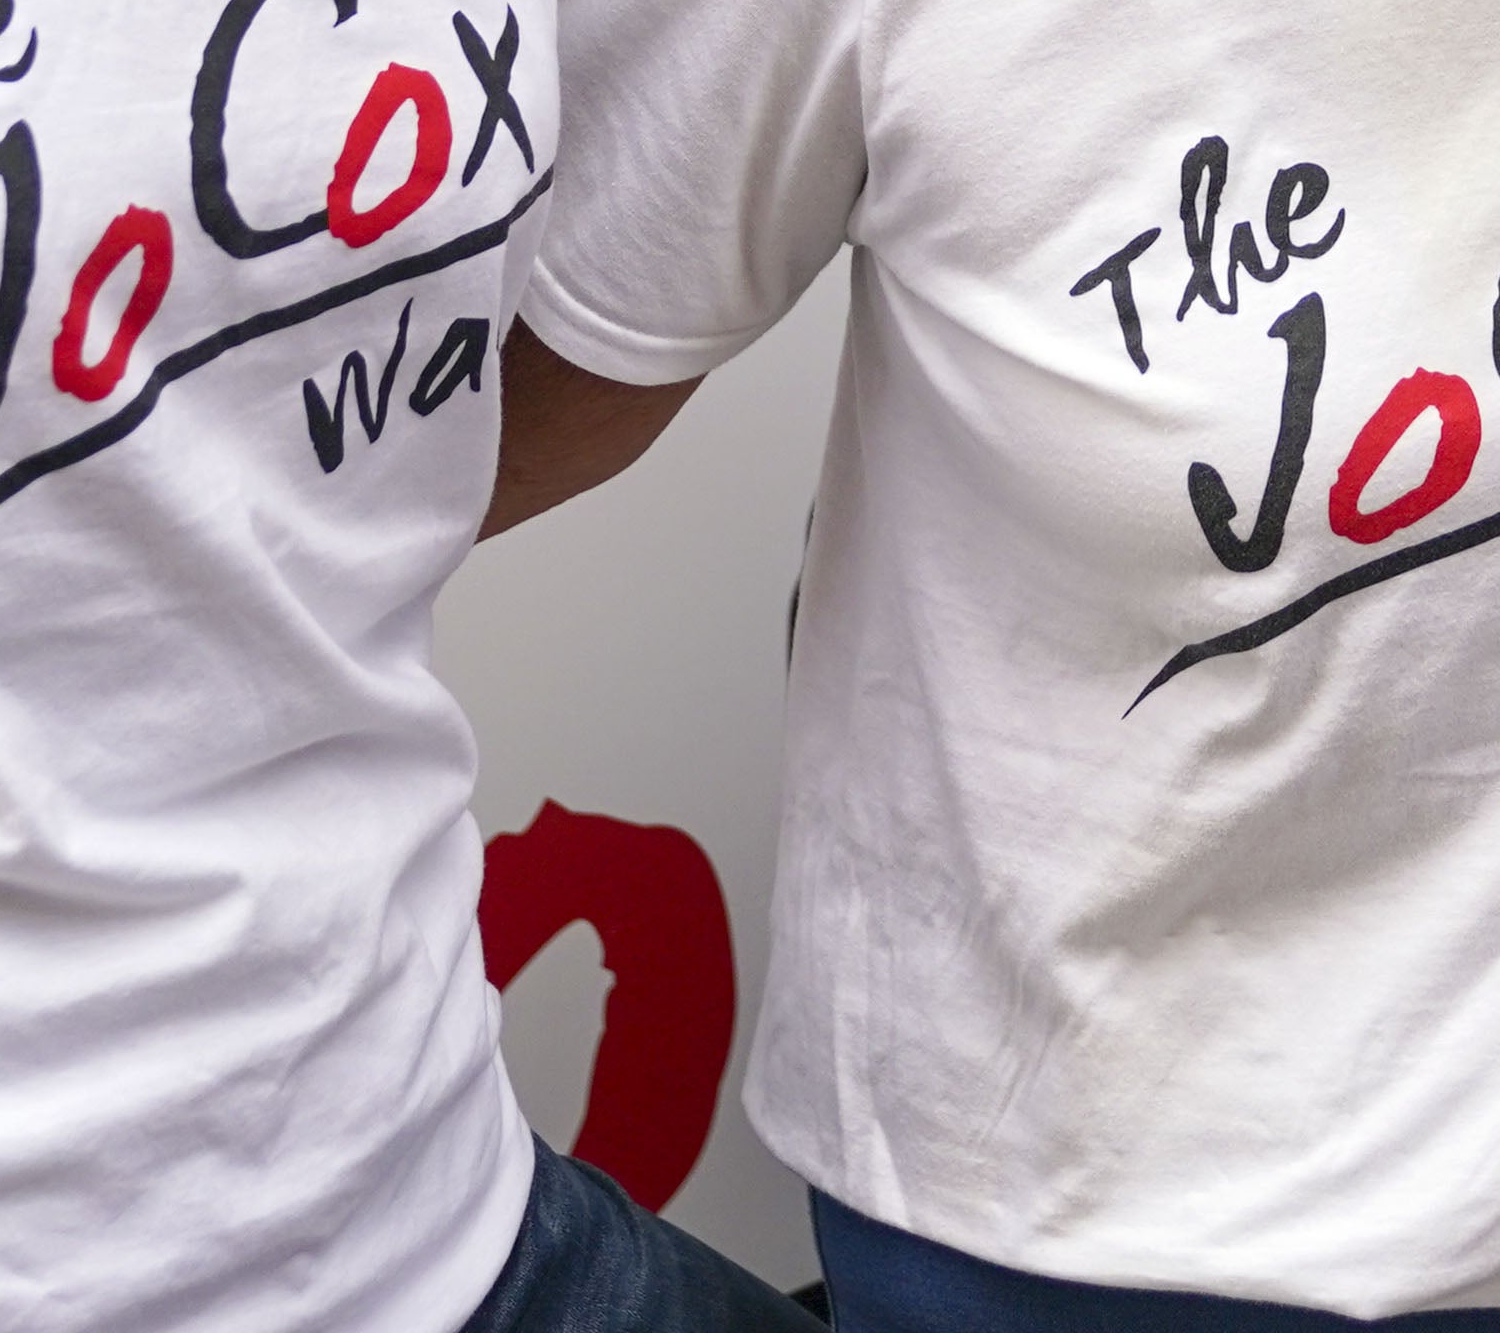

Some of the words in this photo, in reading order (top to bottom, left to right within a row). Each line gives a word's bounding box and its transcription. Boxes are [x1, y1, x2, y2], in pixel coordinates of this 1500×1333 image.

[1069, 136, 1346, 374] The
[303, 297, 499, 474] Wa
[1186, 291, 1482, 572] Jo
